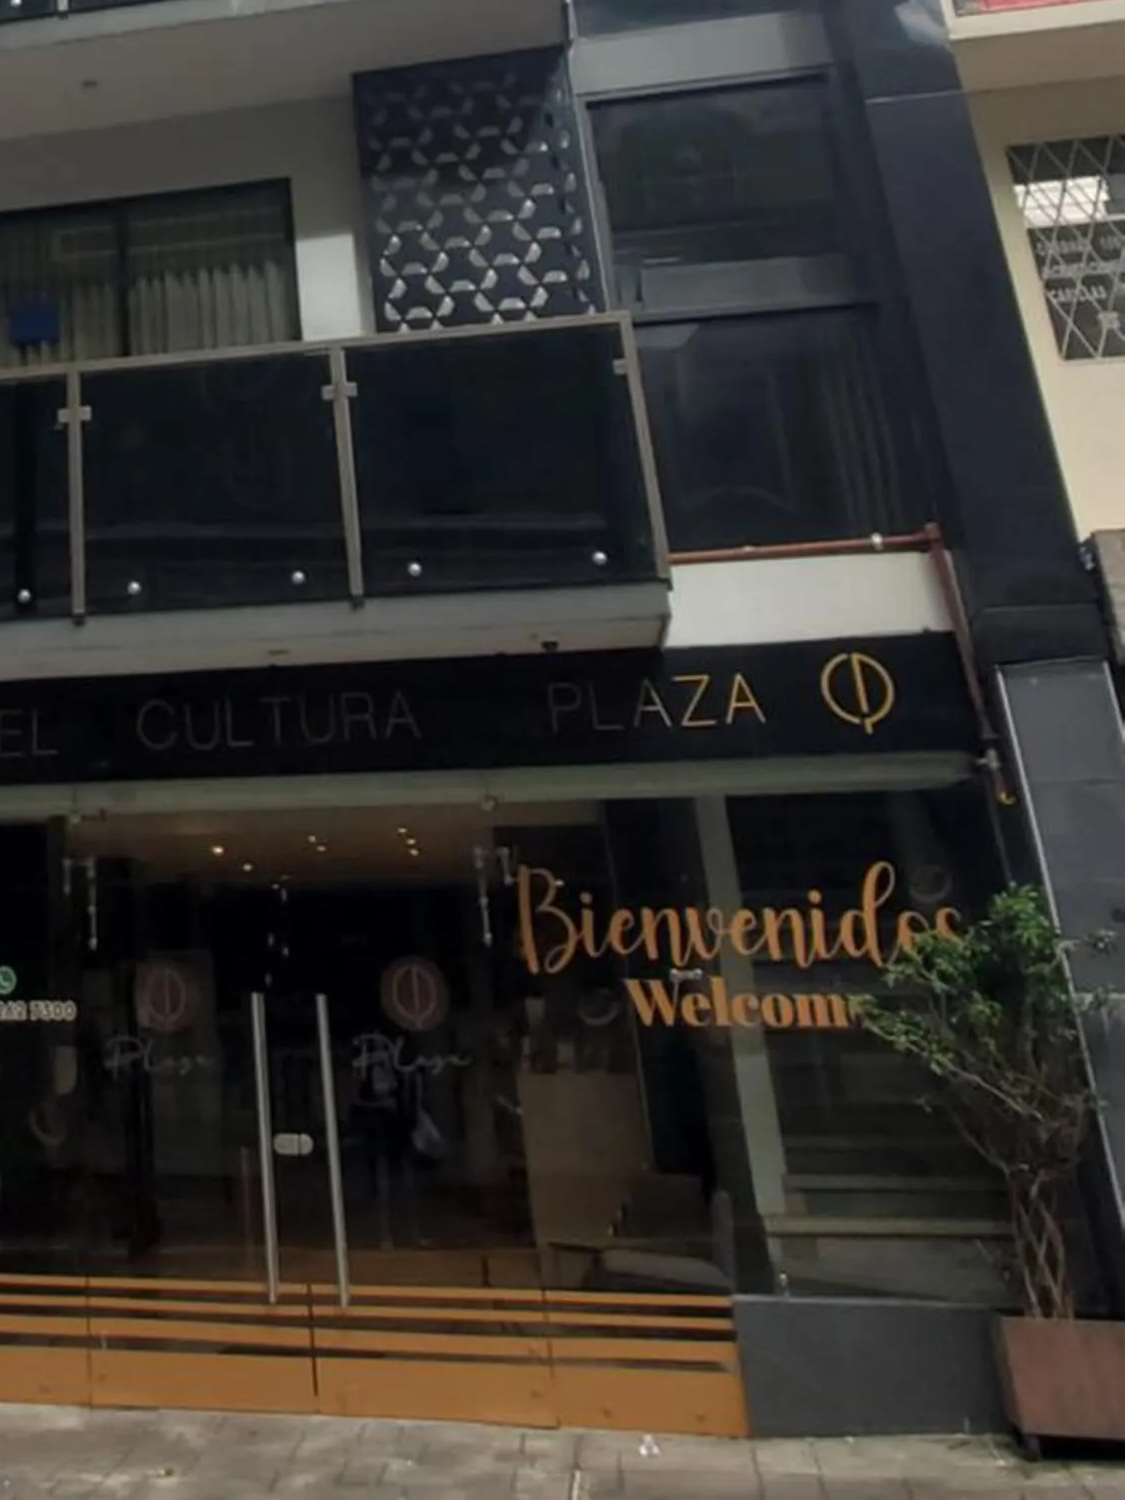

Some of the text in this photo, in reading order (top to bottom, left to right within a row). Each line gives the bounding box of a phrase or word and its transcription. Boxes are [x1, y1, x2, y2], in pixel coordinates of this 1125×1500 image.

[137, 688, 423, 751] CULTURA
[546, 673, 766, 733] PLAZA
[623, 976, 857, 1030] Welcom
